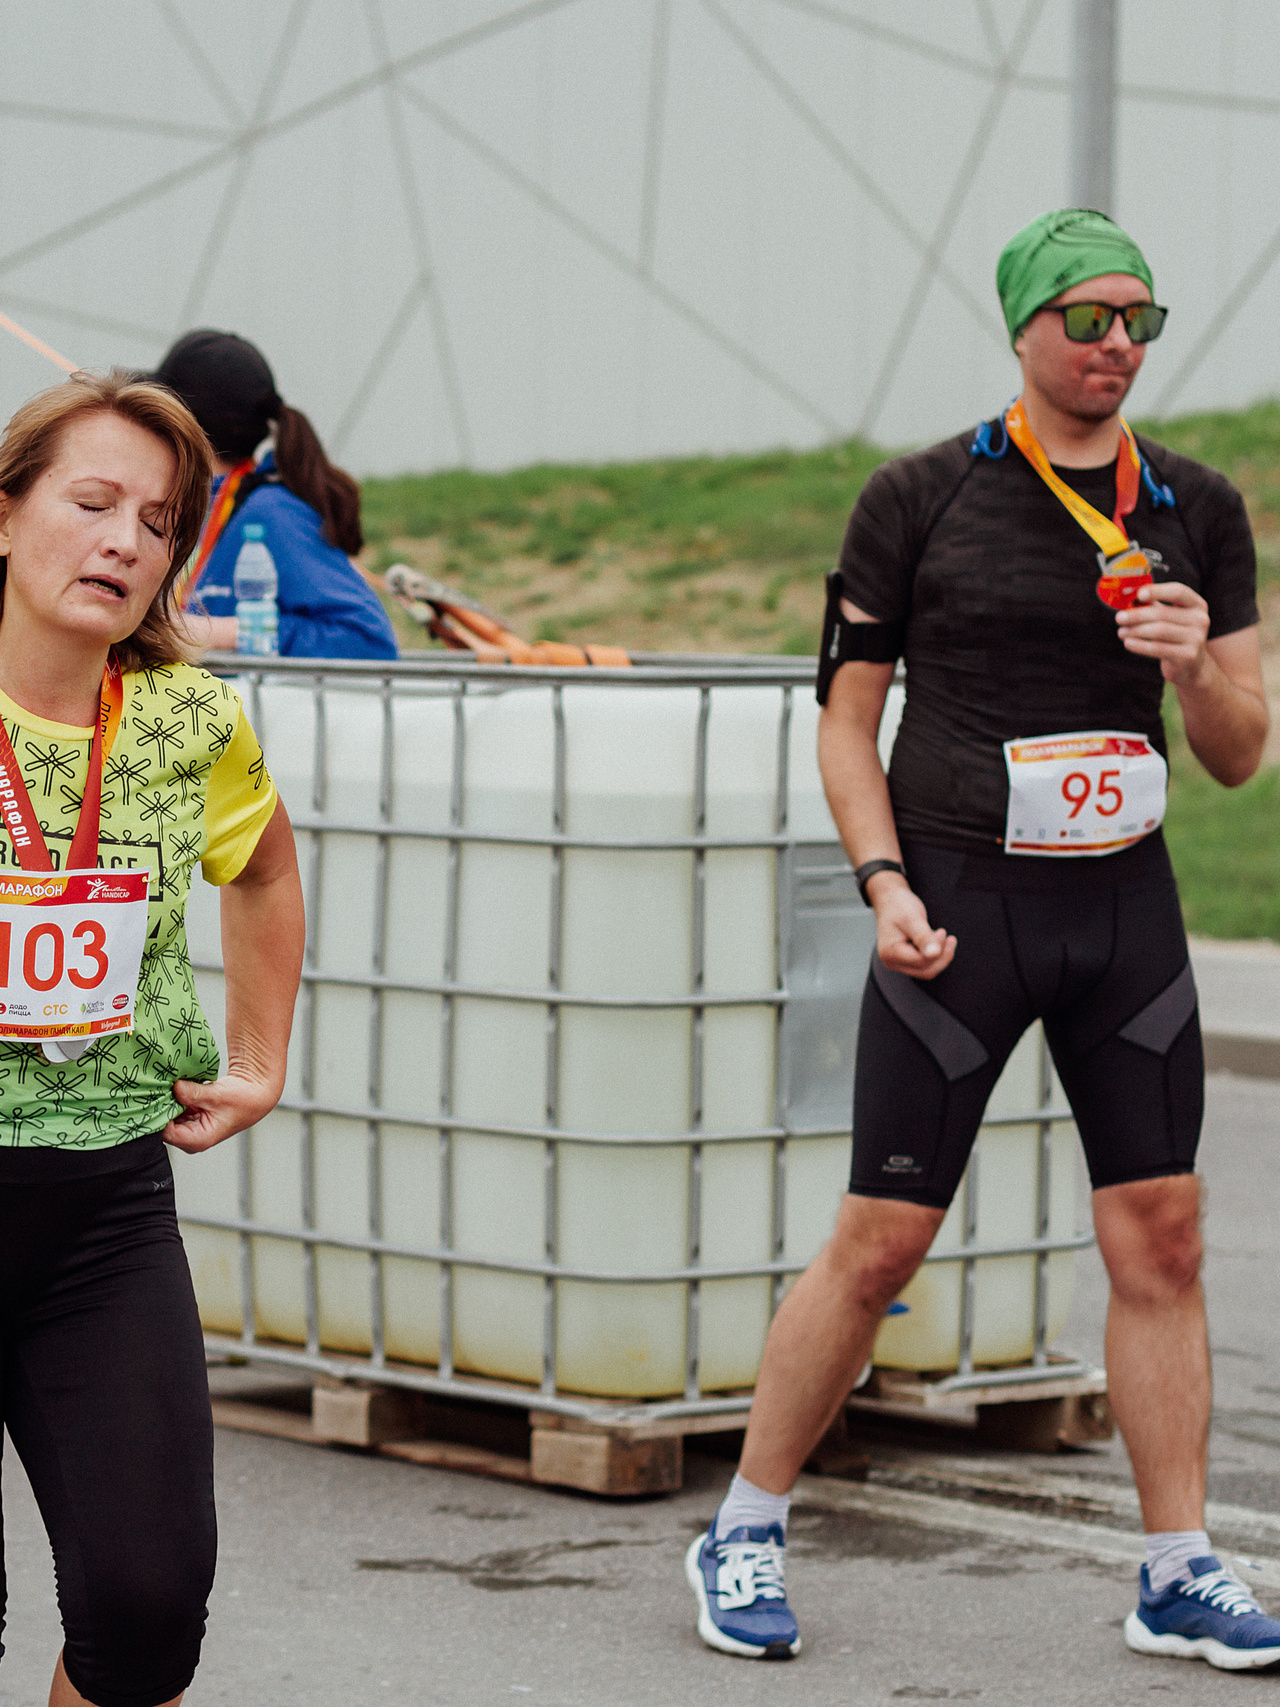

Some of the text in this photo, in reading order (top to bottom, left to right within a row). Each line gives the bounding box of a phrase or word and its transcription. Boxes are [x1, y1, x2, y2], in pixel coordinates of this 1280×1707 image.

[1061, 769, 1123, 819] 95
[42, 1004, 69, 1016] СТС
[50, 1026, 85, 1035] ГАНДИКАП
